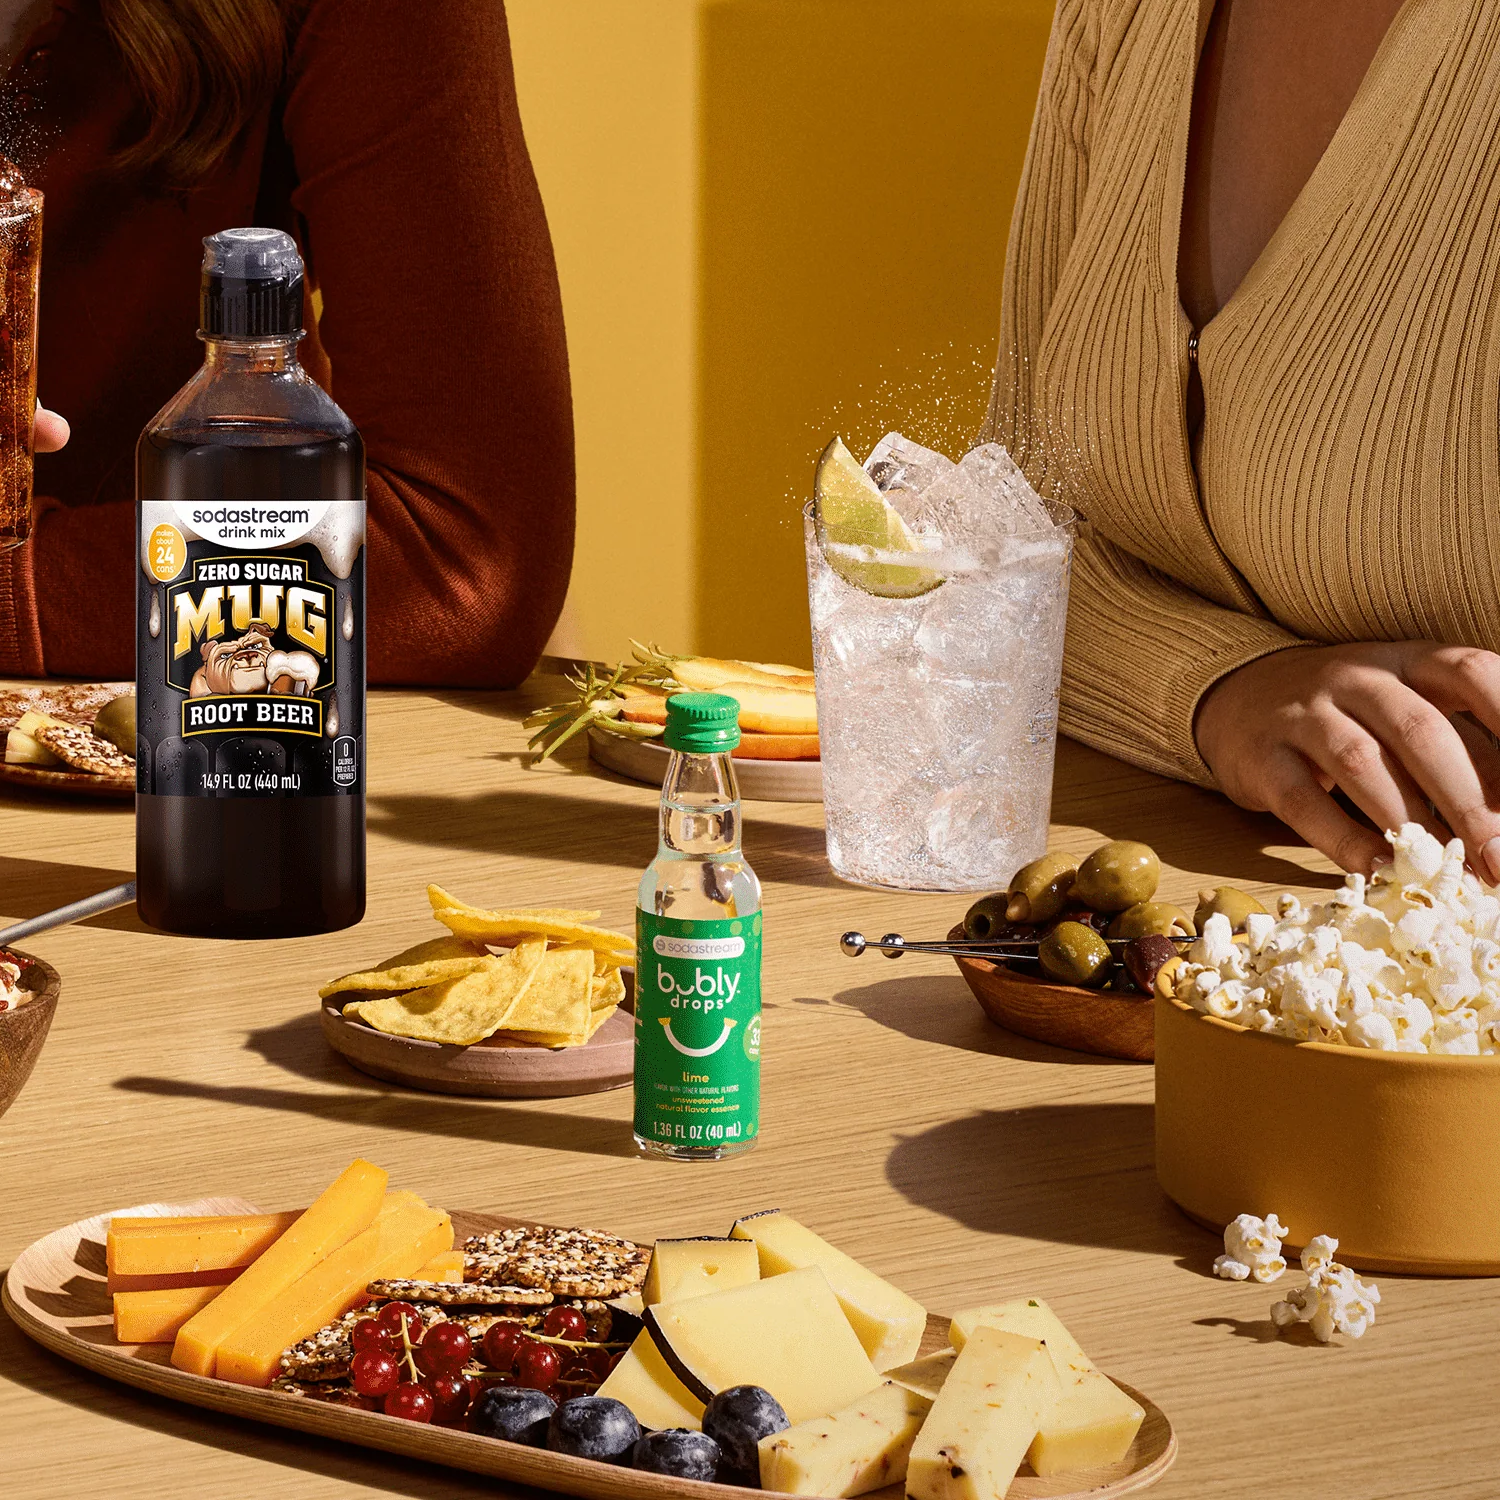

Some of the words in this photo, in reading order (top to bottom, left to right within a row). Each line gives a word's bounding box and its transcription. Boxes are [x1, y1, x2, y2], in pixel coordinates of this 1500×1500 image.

[193, 507, 308, 523] sodastream
[218, 526, 256, 538] drink
[260, 526, 285, 538] mix
[156, 546, 174, 564] 24
[198, 563, 240, 581] ZERO
[244, 563, 302, 581] SUGAR
[174, 584, 327, 660] MUG
[190, 702, 248, 726] ROOT
[256, 702, 313, 726] BEER
[201, 773, 220, 789] 14.9
[223, 774, 235, 789] FL
[238, 774, 251, 789] OZ
[254, 773, 278, 791] (440
[281, 773, 300, 790] mL)
[668, 941, 741, 954] sodastream
[670, 994, 724, 1014] drops
[682, 1072, 709, 1082] lime
[656, 1103, 683, 1112] natural
[685, 1105, 709, 1113] flavor
[672, 1096, 724, 1104] unsweetened
[654, 1121, 671, 1137] 1.36
[675, 1124, 686, 1139] FL
[689, 1125, 702, 1139] OZ
[705, 1123, 723, 1141] (40
[725, 1120, 741, 1138] mL)
